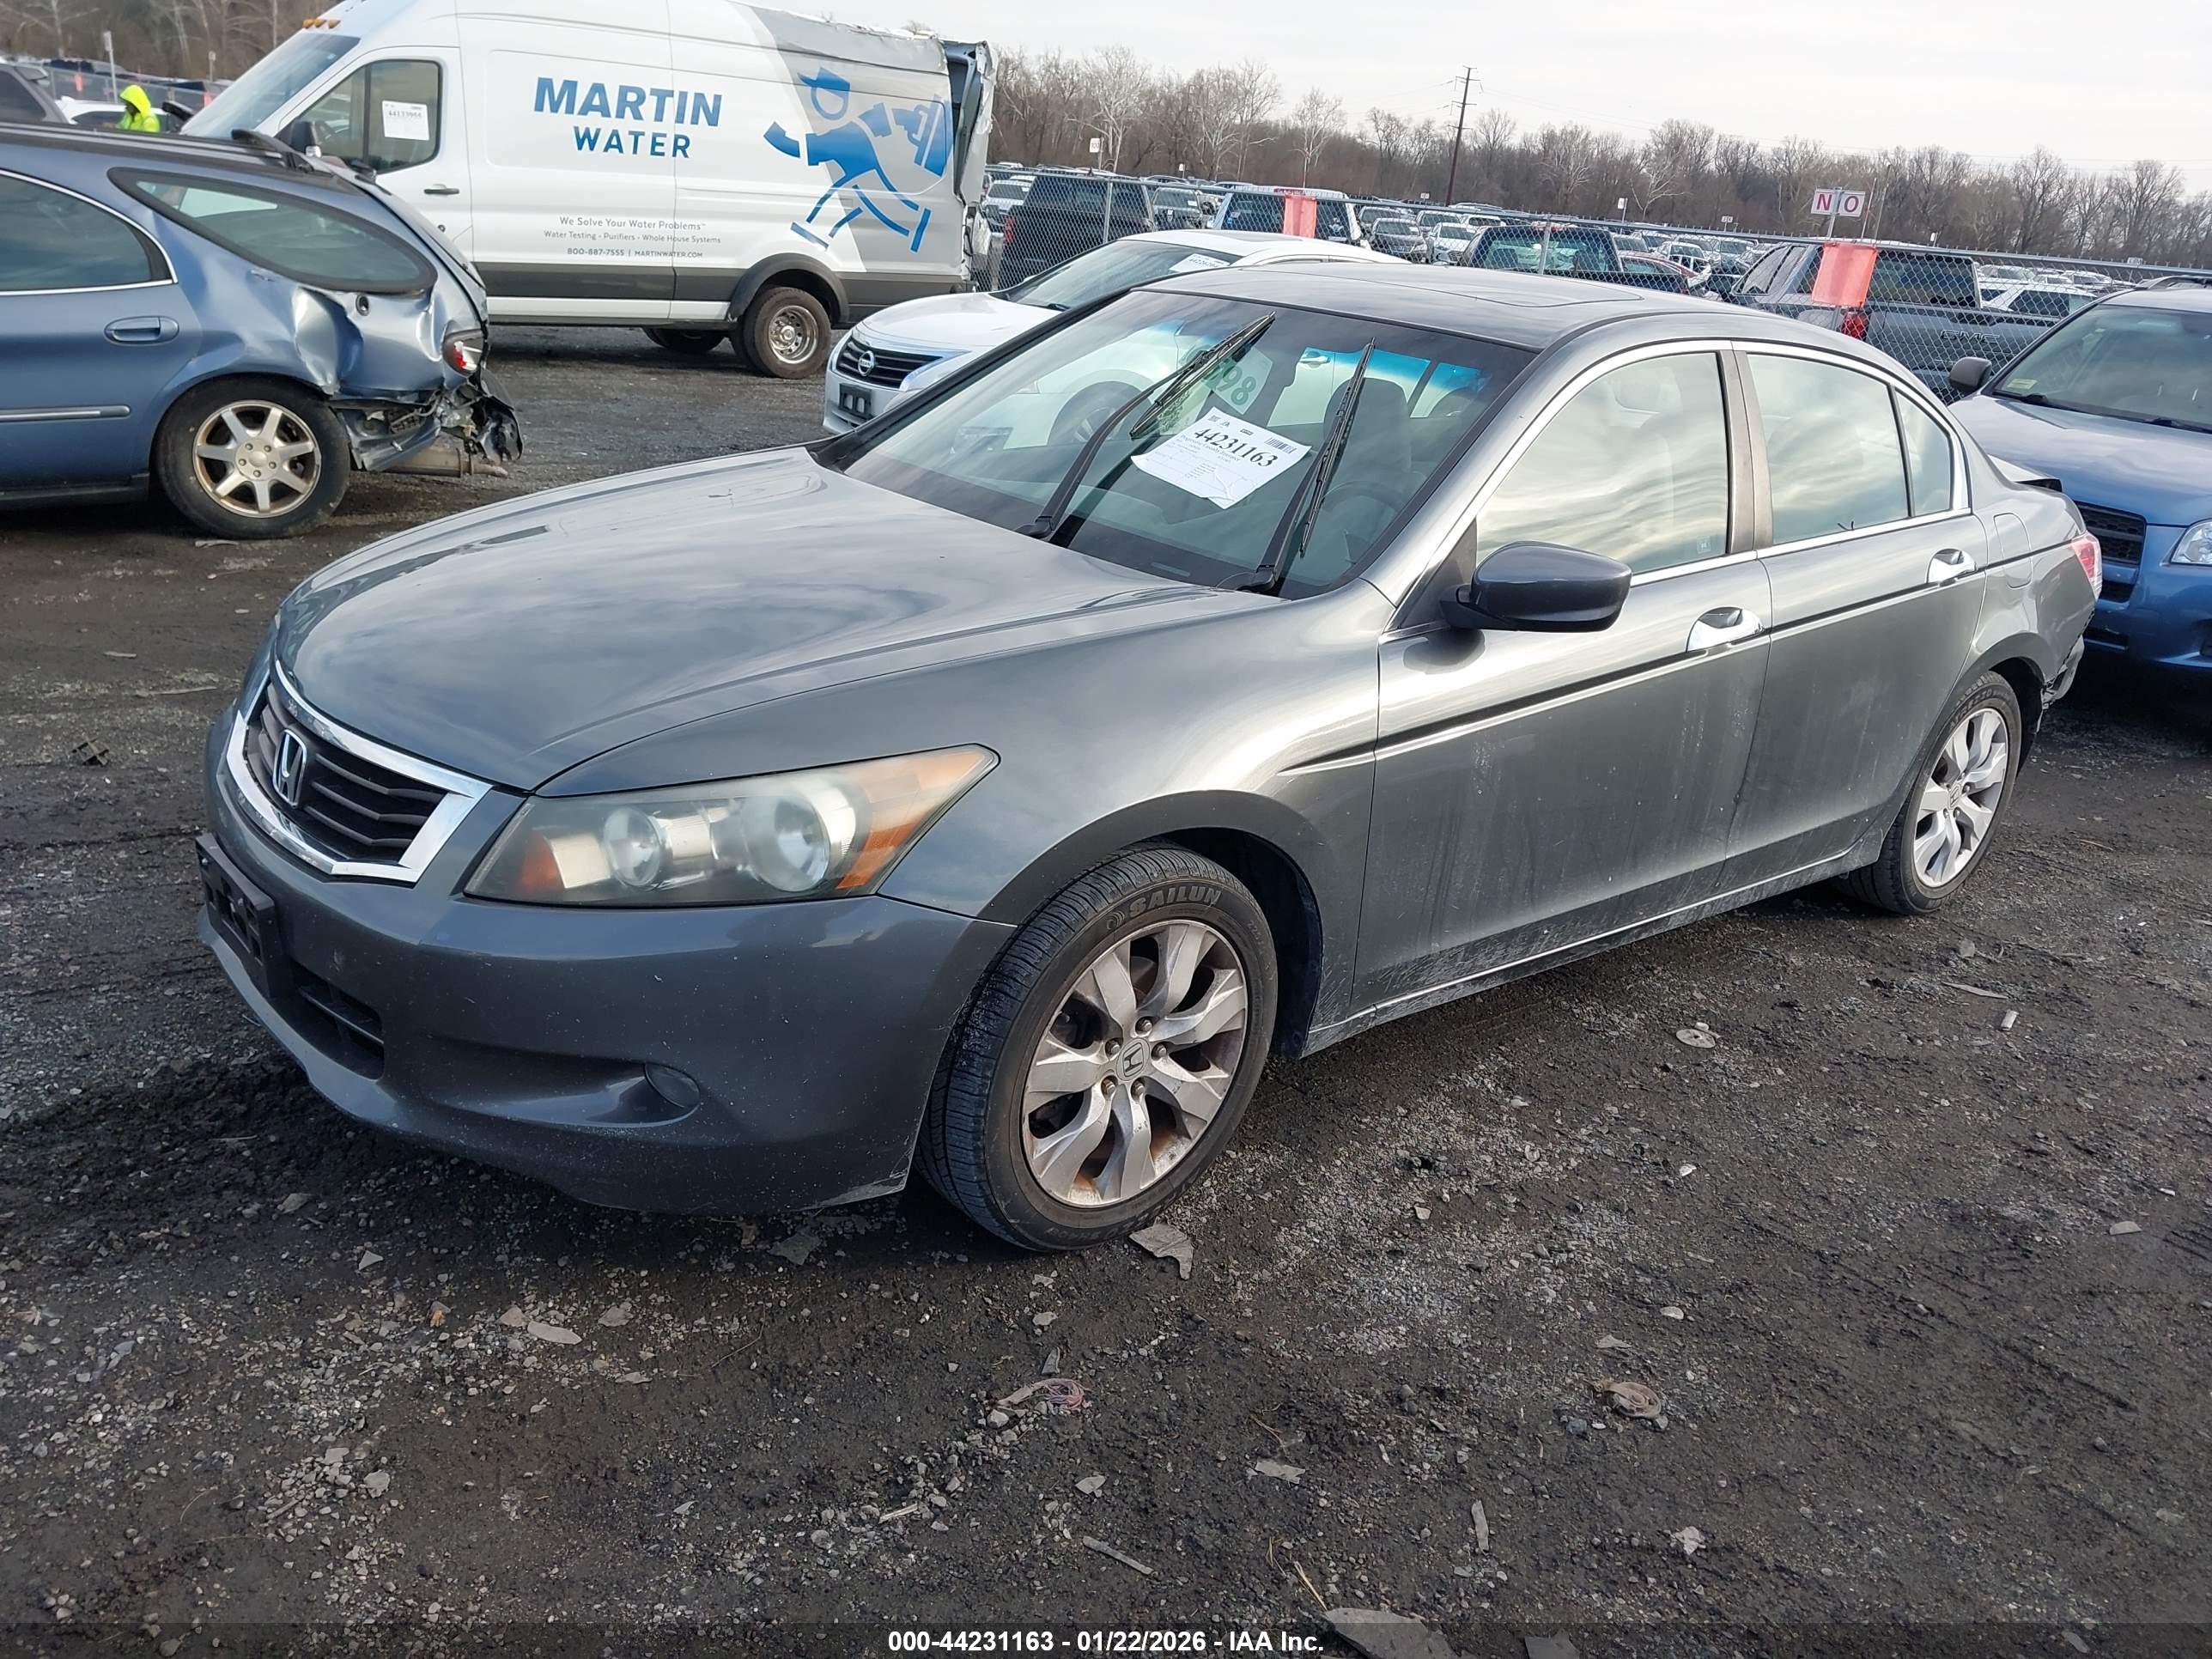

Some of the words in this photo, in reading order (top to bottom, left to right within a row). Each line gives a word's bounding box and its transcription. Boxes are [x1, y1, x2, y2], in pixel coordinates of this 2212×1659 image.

[534, 77, 721, 127] MARTIN
[574, 126, 690, 158] WATER
[577, 217, 603, 227] Solve
[629, 220, 655, 228] Water
[568, 231, 597, 240] Testing
[692, 235, 721, 244] Systems
[635, 250, 702, 258] MARTINWATER.COM
[1941, 330, 2000, 344] GMC
[1194, 428, 1279, 467] 44231163
[1130, 885, 1221, 917] SAILUN
